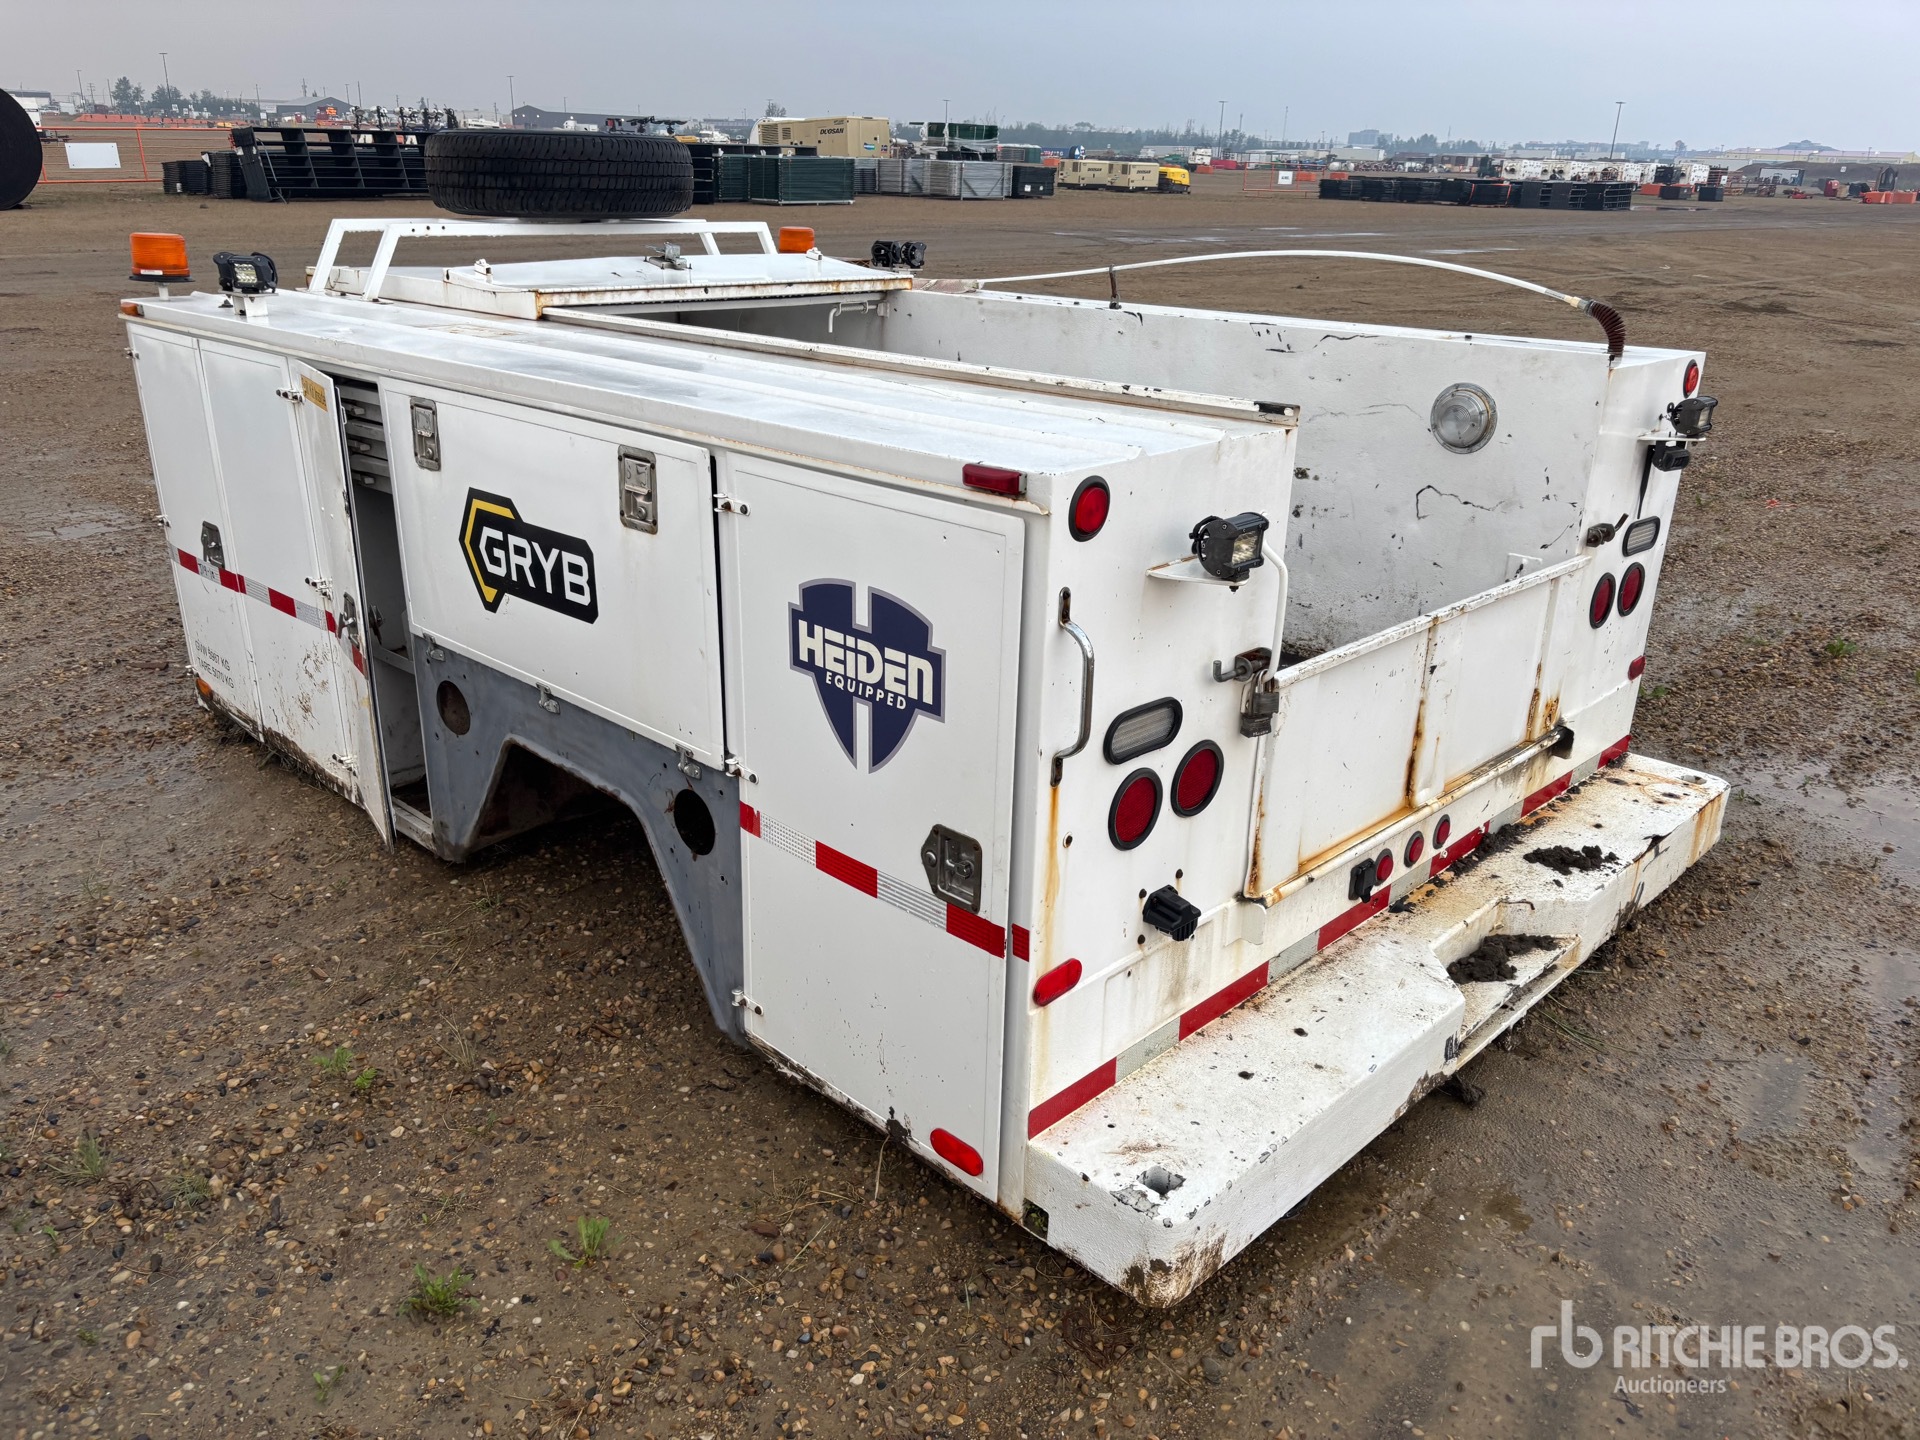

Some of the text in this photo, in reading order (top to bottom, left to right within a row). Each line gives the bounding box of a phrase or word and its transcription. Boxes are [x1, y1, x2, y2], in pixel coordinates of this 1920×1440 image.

[479, 526, 591, 606] GRYB
[221, 657, 230, 671] KG
[798, 619, 933, 705] HEIDEN
[225, 675, 234, 689] KG
[825, 671, 906, 710] EQUIPPED
